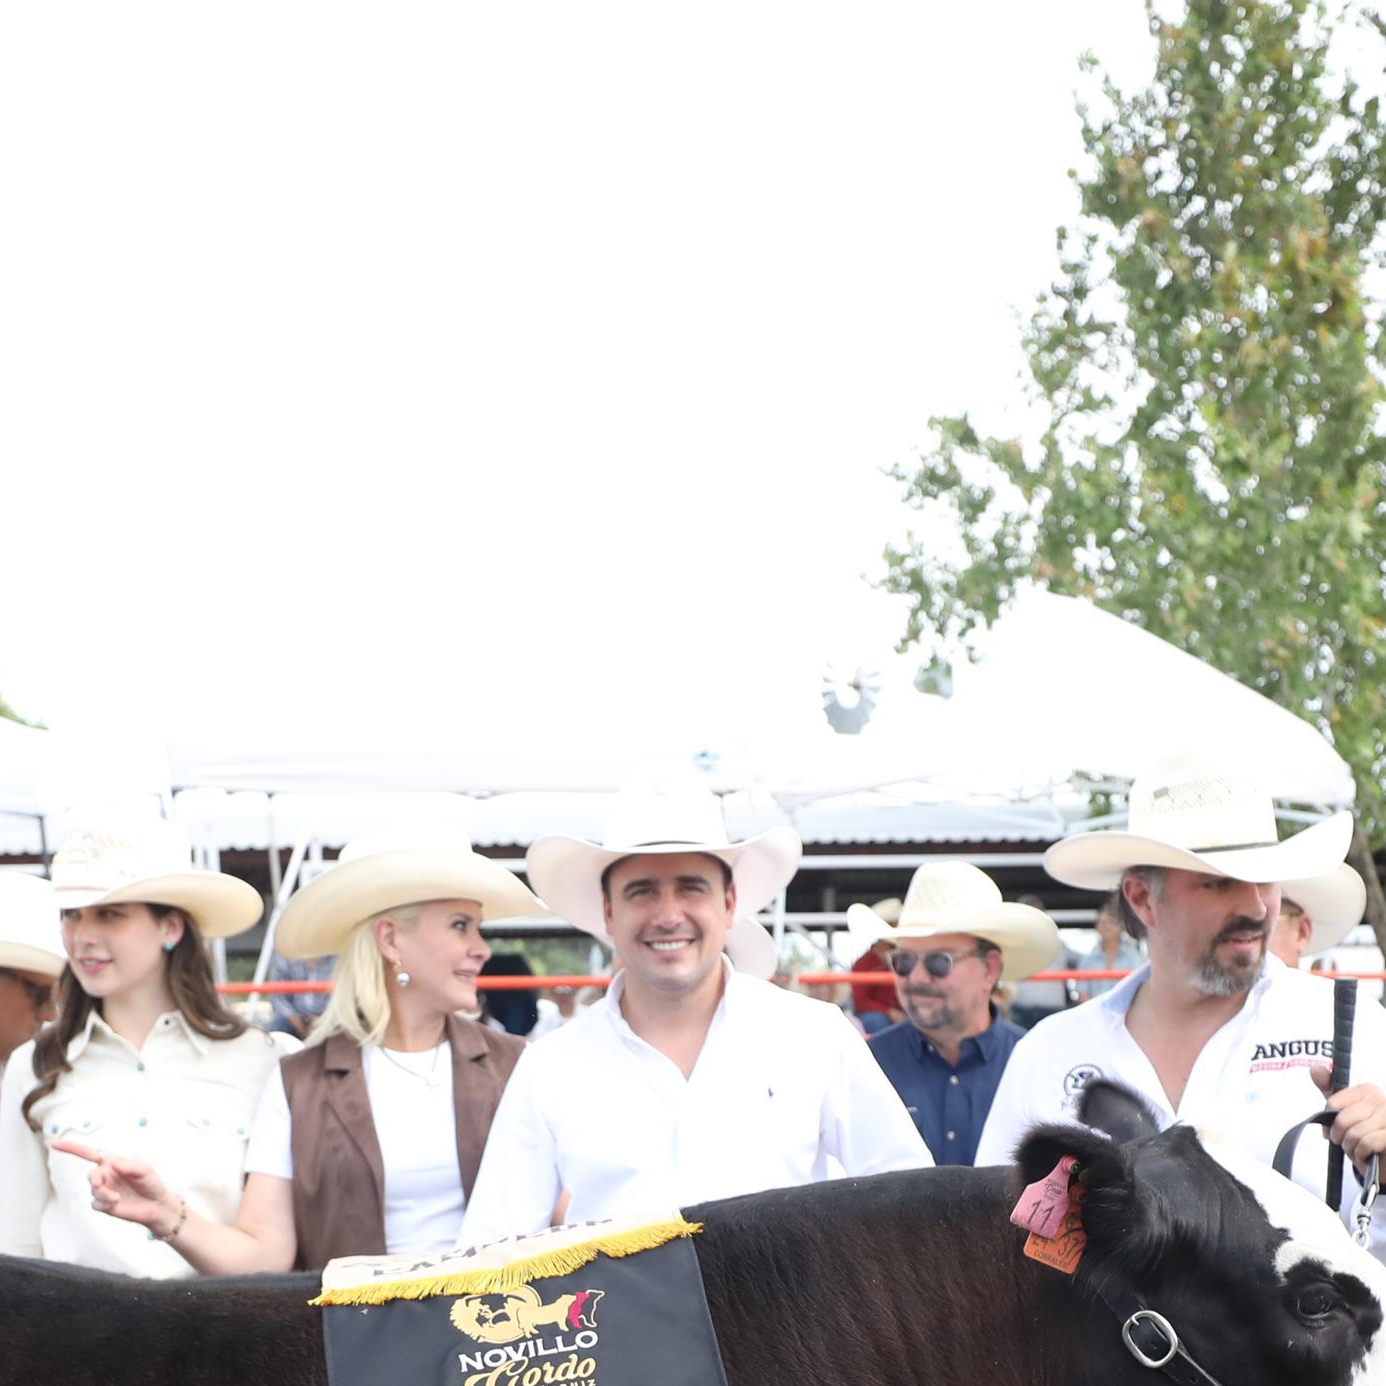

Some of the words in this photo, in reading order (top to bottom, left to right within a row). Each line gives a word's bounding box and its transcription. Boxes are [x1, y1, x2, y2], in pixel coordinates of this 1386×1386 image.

[1251, 1040, 1333, 1061] ANGUS
[1027, 1199, 1055, 1233] 11
[458, 1330, 598, 1372] NOVILLO
